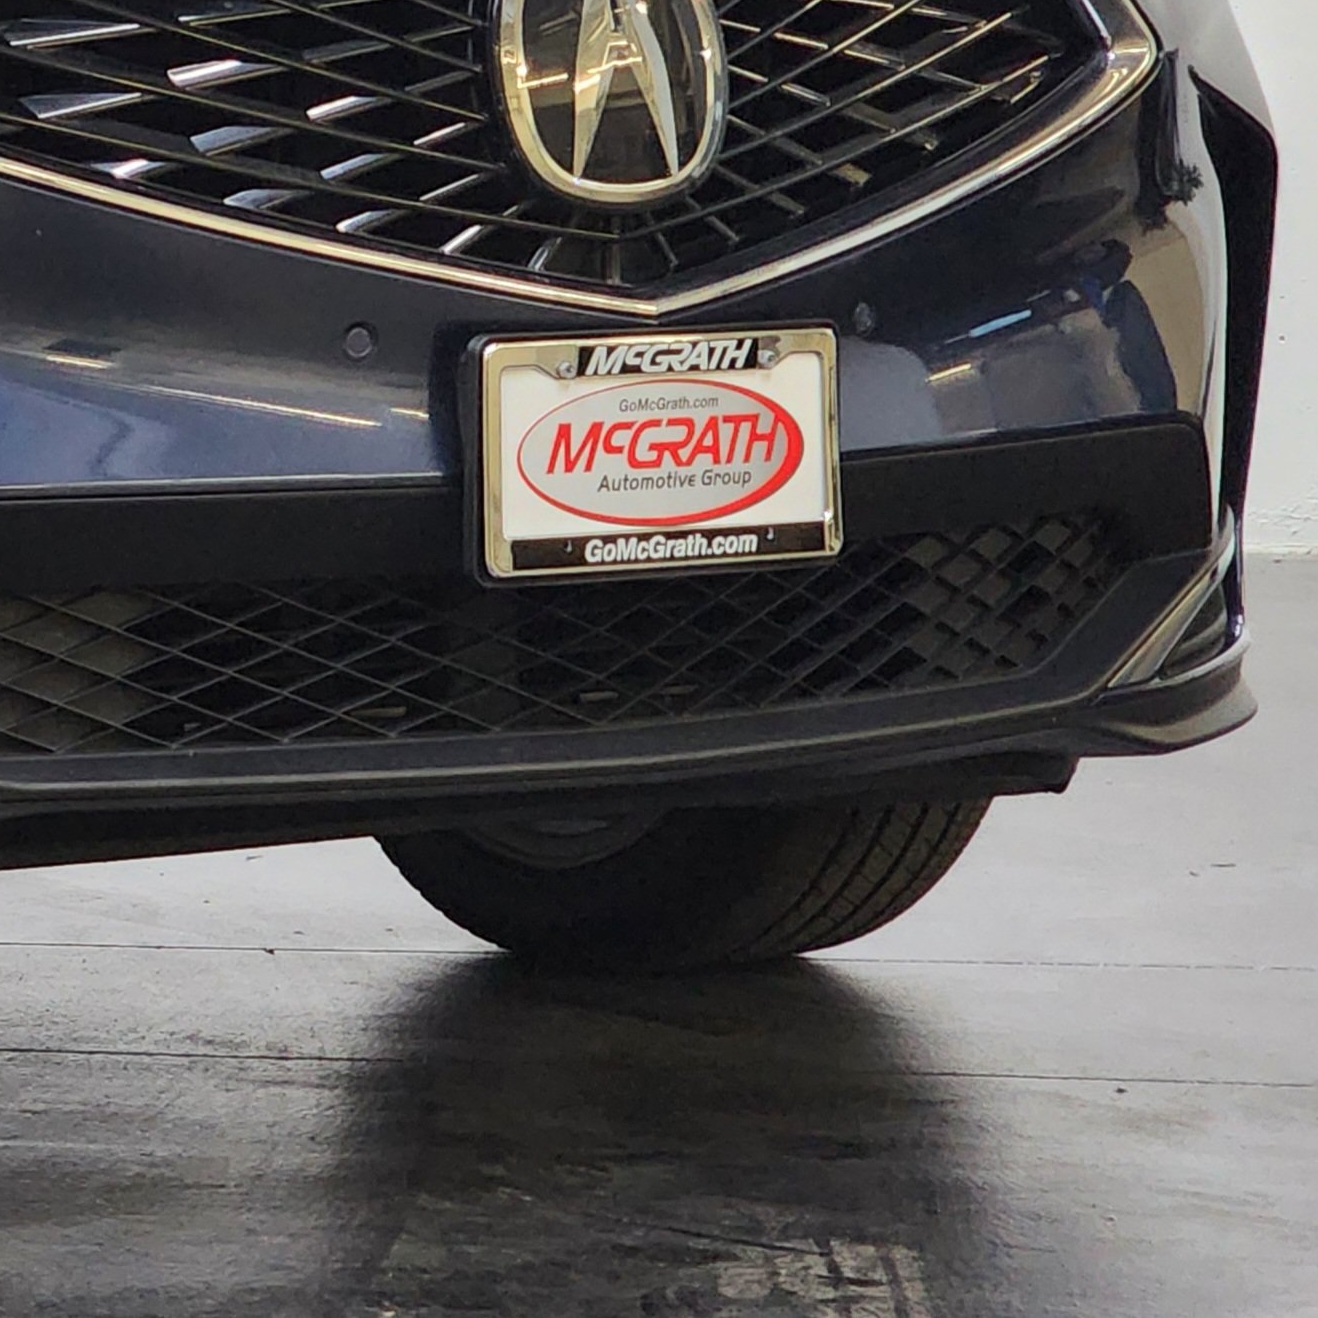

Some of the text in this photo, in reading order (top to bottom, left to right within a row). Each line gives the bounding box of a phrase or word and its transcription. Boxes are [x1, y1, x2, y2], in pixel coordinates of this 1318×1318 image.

[585, 338, 752, 376] McGRATH
[619, 397, 719, 414] GoMcGrath.com
[546, 414, 780, 475] McGRATH
[597, 469, 752, 493] Automotive Group
[584, 533, 758, 564] GoMcGrath.com
